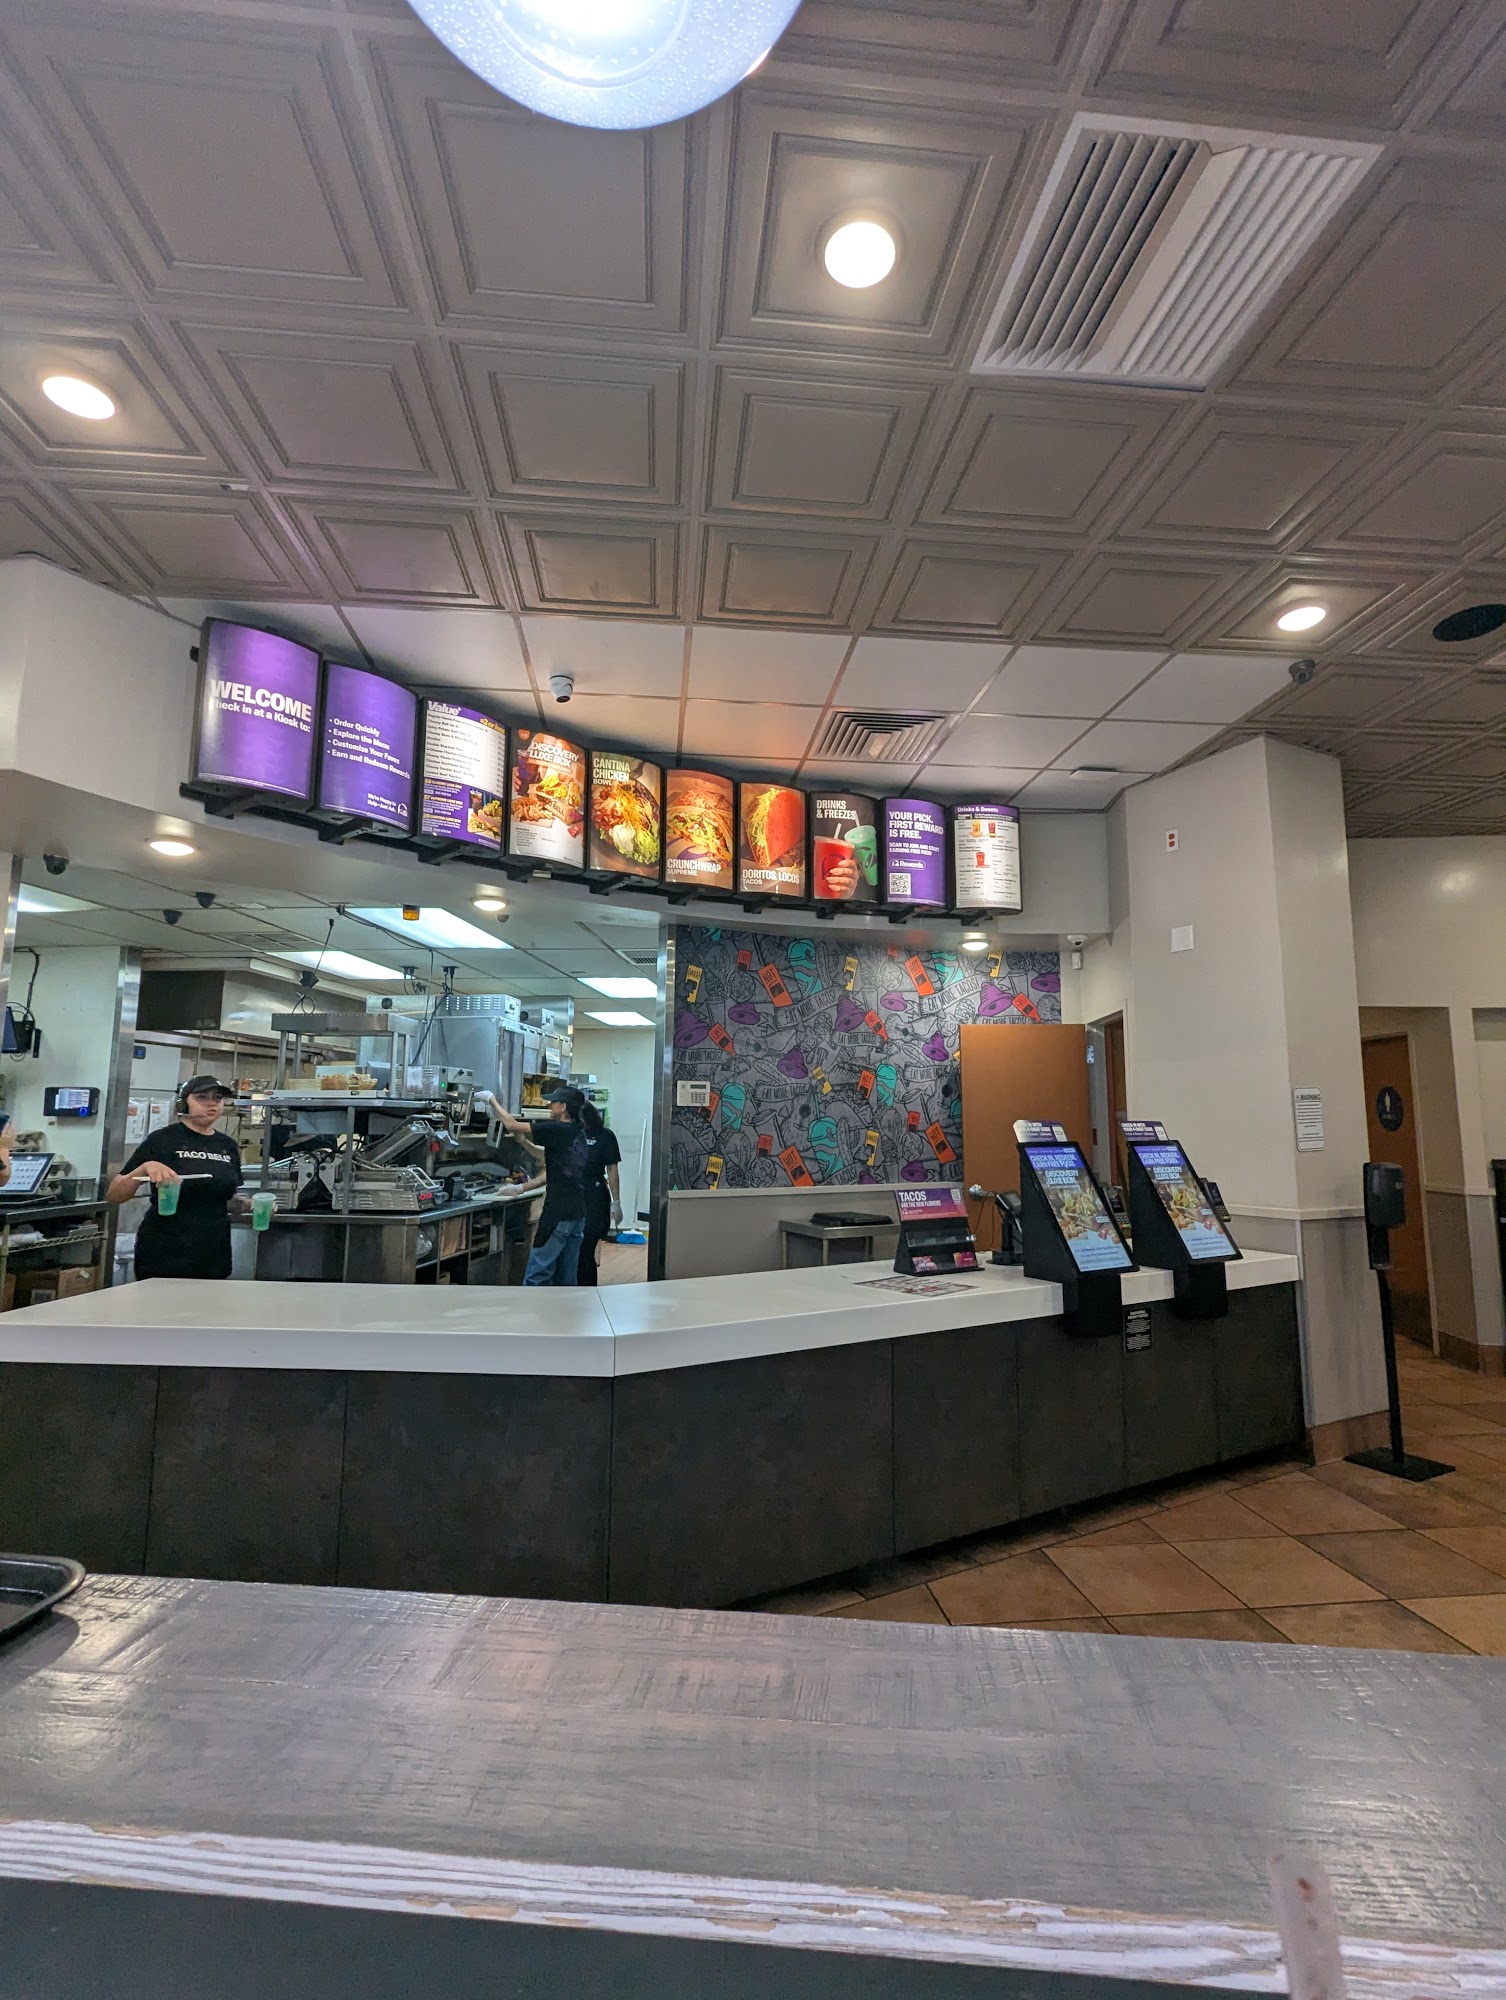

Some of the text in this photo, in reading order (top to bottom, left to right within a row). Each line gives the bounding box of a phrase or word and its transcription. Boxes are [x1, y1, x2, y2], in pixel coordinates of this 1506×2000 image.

[210, 680, 312, 722] WELCOME
[209, 699, 310, 732] heck in at a Kiosk to:
[334, 718, 380, 737] Order Quickly
[333, 728, 390, 750] Explore the Menu
[332, 738, 400, 764] Customize Your Faves
[531, 742, 579, 762] DISCOVERY
[332, 749, 348, 758] Earn
[364, 756, 388, 770] Redeem
[530, 750, 552, 762] LUXE
[553, 756, 572, 768] BOX
[593, 758, 630, 772] CANTINA
[592, 778, 612, 786] BOWL
[593, 768, 630, 782] CHICKEN
[816, 800, 846, 810] DRINKS
[816, 809, 856, 820] & FREEZES
[889, 811, 933, 824] YOUR PICK.
[889, 820, 944, 834] FIRST REWARD
[890, 829, 922, 840] IS FREE.
[667, 858, 721, 874] CRUNCHWRAP
[900, 860, 923, 868] Rewards
[667, 868, 698, 876] SUPREME
[778, 872, 800, 884] LOCOS
[909, 960, 919, 972] HOT
[762, 968, 776, 984] HOT
[928, 996, 938, 1010] EAT
[938, 989, 956, 1007] MORE
[784, 1008, 795, 1024] EAT
[799, 1002, 816, 1020] MORE
[176, 1150, 206, 1160] TACO
[1045, 1170, 1078, 1178] DISCOVERY
[1153, 1166, 1182, 1174] DISCOVERY
[898, 1191, 926, 1202] TACOS
